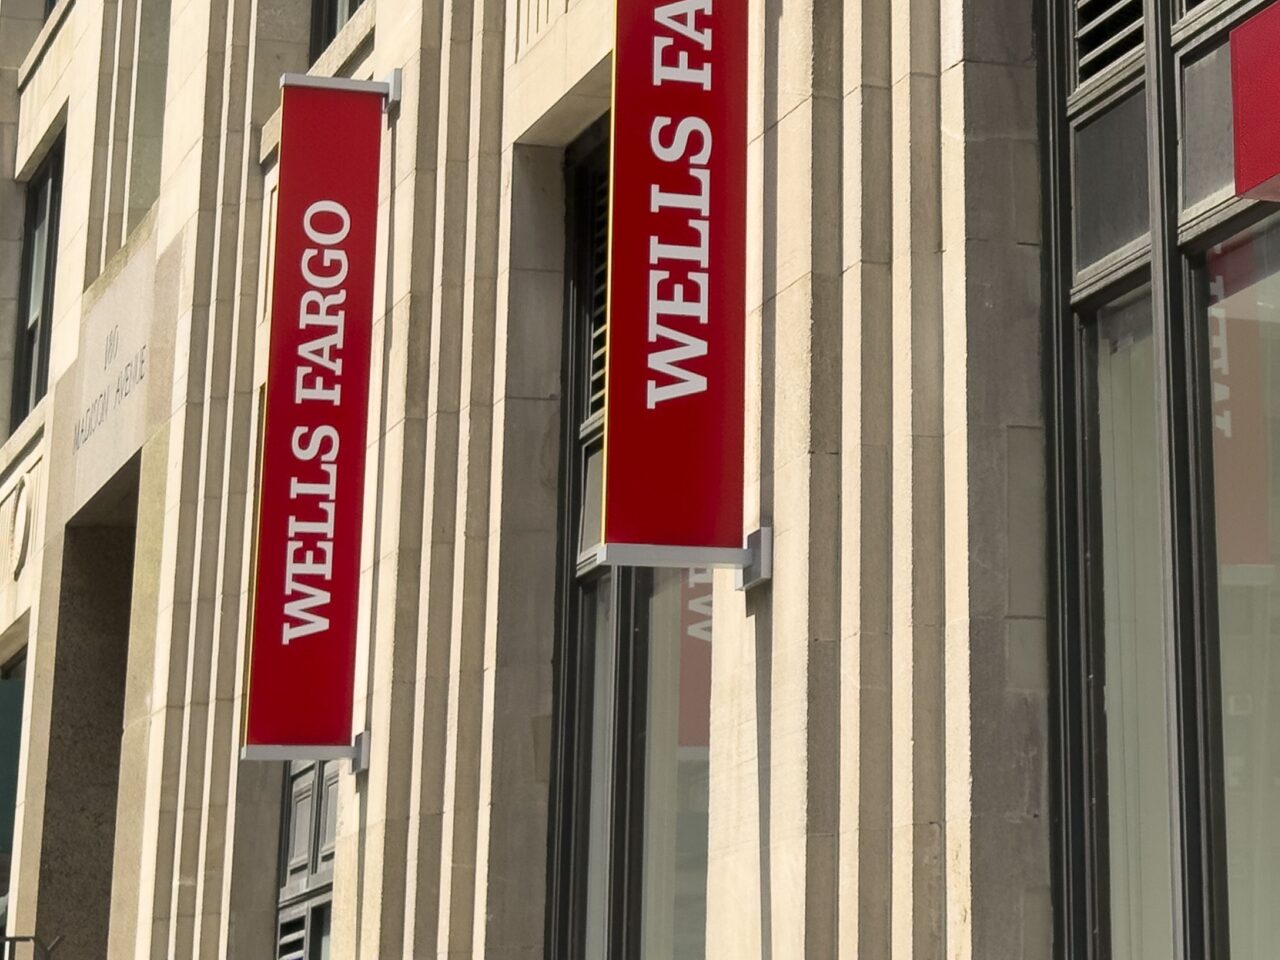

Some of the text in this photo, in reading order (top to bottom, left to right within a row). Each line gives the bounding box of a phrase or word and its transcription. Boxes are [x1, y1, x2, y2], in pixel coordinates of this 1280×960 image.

[282, 200, 351, 645] WELLS FARGO
[646, 115, 713, 410] WELLS
